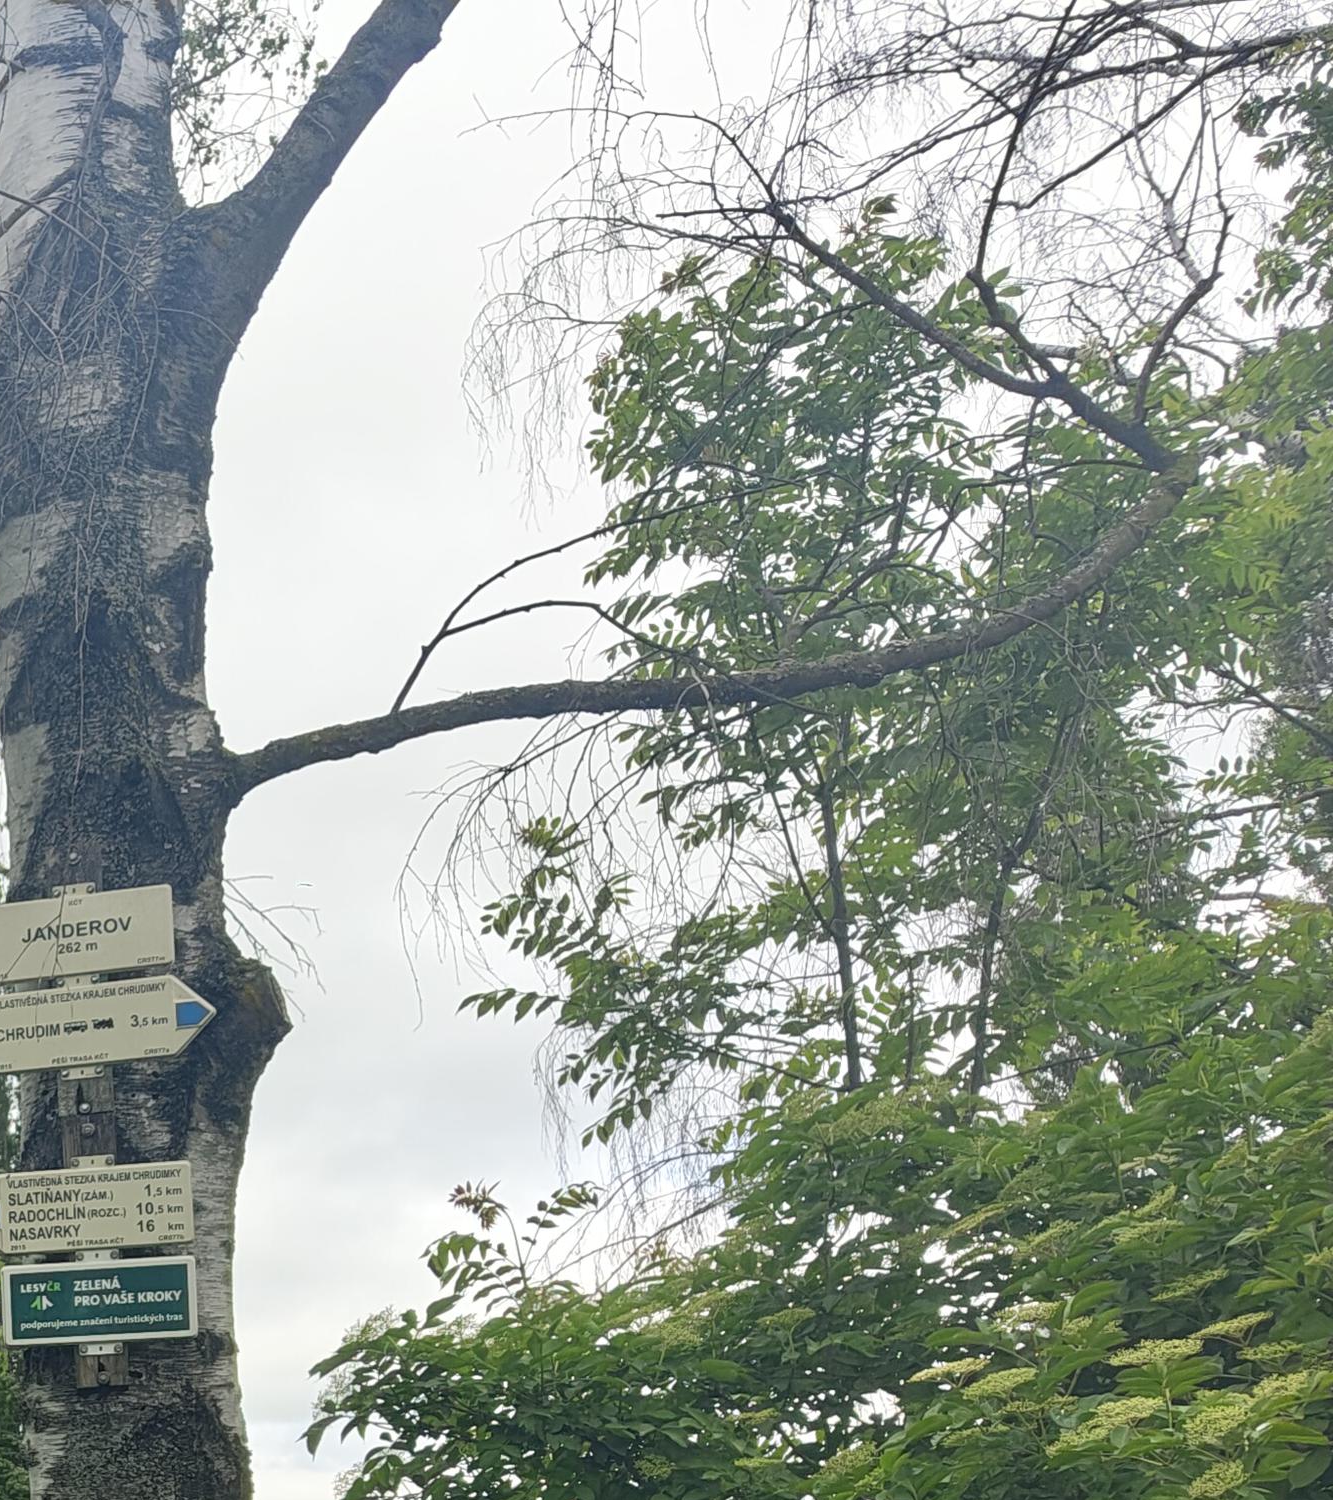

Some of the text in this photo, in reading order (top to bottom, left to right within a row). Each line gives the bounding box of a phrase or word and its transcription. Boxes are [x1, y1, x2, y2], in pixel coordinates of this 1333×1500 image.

[22, 916, 133, 944] JANDEROV
[58, 941, 98, 954] 262 m
[50, 989, 82, 1005] STEZKA
[83, 986, 117, 1001] KRAJEM
[118, 981, 167, 997] CHRUDIMKY
[130, 1014, 150, 1029] 3,5
[152, 1015, 169, 1026] km
[7, 1168, 182, 1189] VLASTIVĚDNÁ STEZKA KRAJEM CHRUDIMKY
[8, 1186, 81, 1206] SLATIŇANY
[144, 1183, 162, 1198] 1,5
[166, 1186, 183, 1196] km
[8, 1203, 86, 1224] RADOCHLÍN
[136, 1202, 164, 1216] 10,5
[167, 1204, 184, 1214] km
[9, 1219, 185, 1241] NASAVRKY 16 km
[73, 1275, 121, 1292] ZELENÁ
[74, 1290, 182, 1307] PRO VAŠE KROKY
[21, 1312, 184, 1331] podporujeme značení turistických tras
